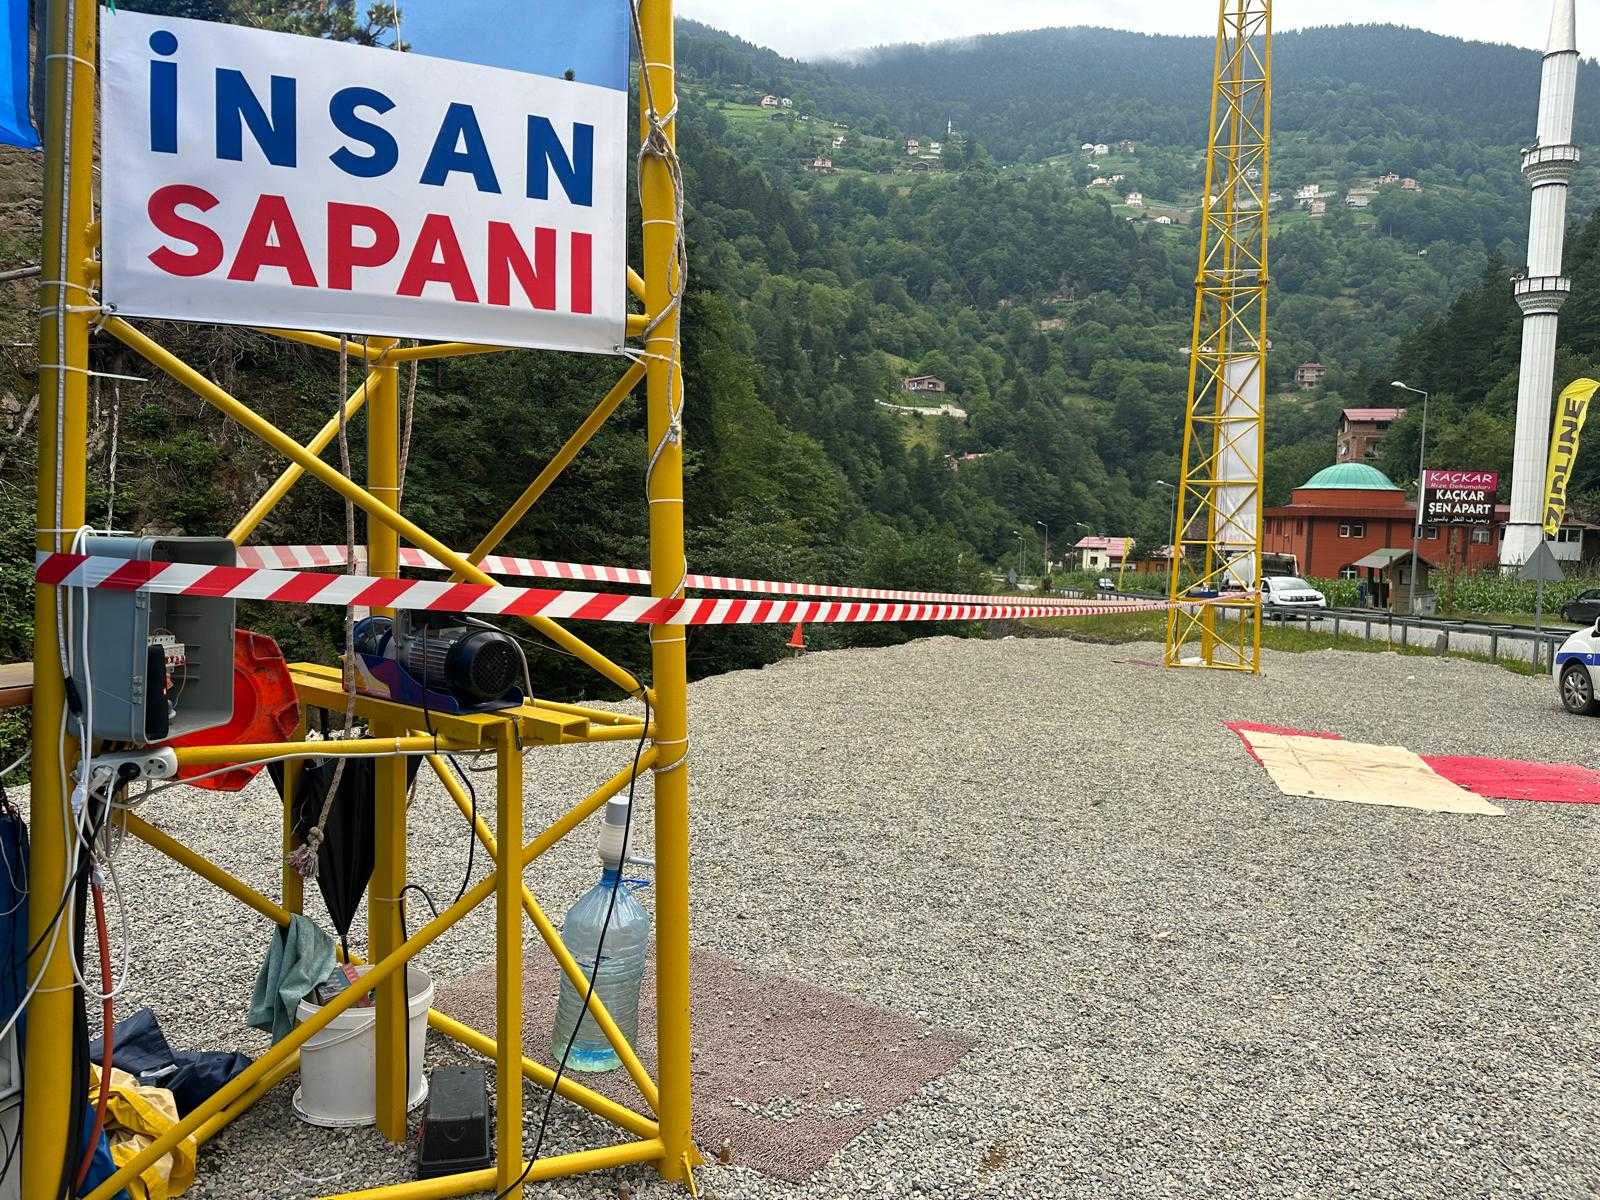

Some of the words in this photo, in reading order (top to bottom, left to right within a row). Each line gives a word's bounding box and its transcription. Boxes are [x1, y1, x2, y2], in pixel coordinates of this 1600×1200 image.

[149, 30, 594, 207] İNSAN
[147, 184, 593, 315] SAPANI
[1430, 472, 1493, 484] KAÇKAR
[1436, 489, 1485, 502] KAÇKAR
[1428, 502, 1451, 515] ŞEN
[1453, 503, 1491, 515] APART
